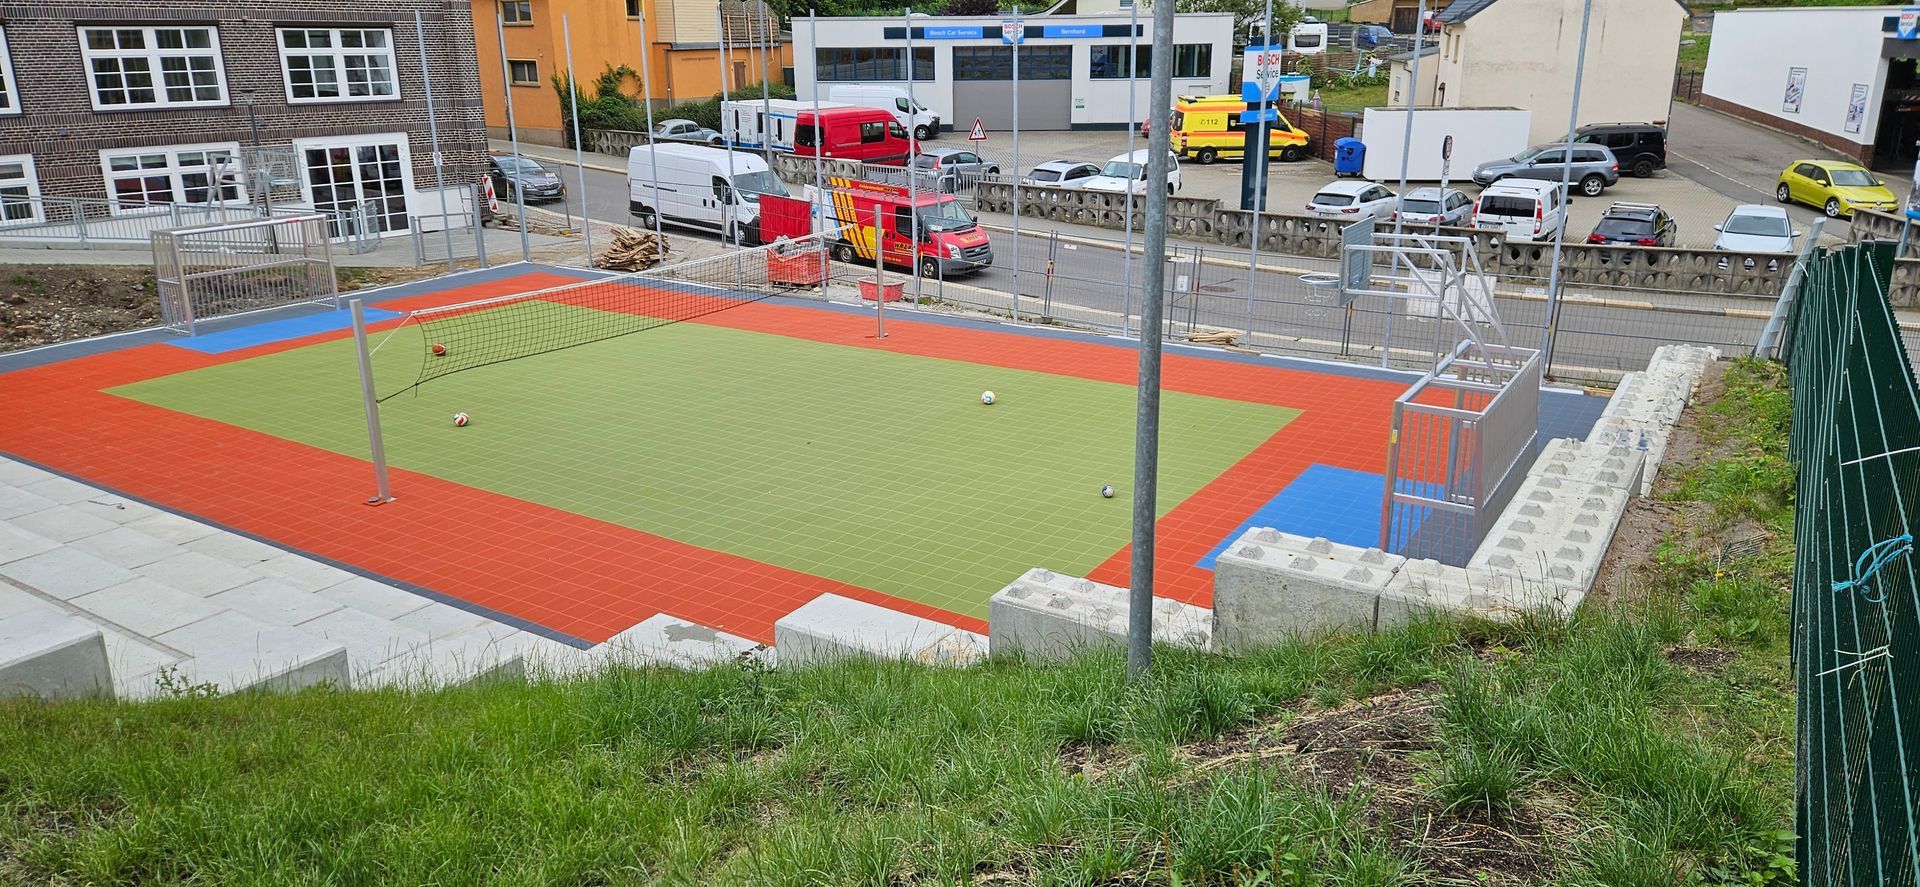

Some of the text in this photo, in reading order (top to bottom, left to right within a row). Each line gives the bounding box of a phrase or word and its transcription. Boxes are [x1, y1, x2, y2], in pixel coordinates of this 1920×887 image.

[1257, 53, 1280, 66] BSCH
[1256, 69, 1279, 80] Sevice
[894, 241, 914, 250] WRZA
